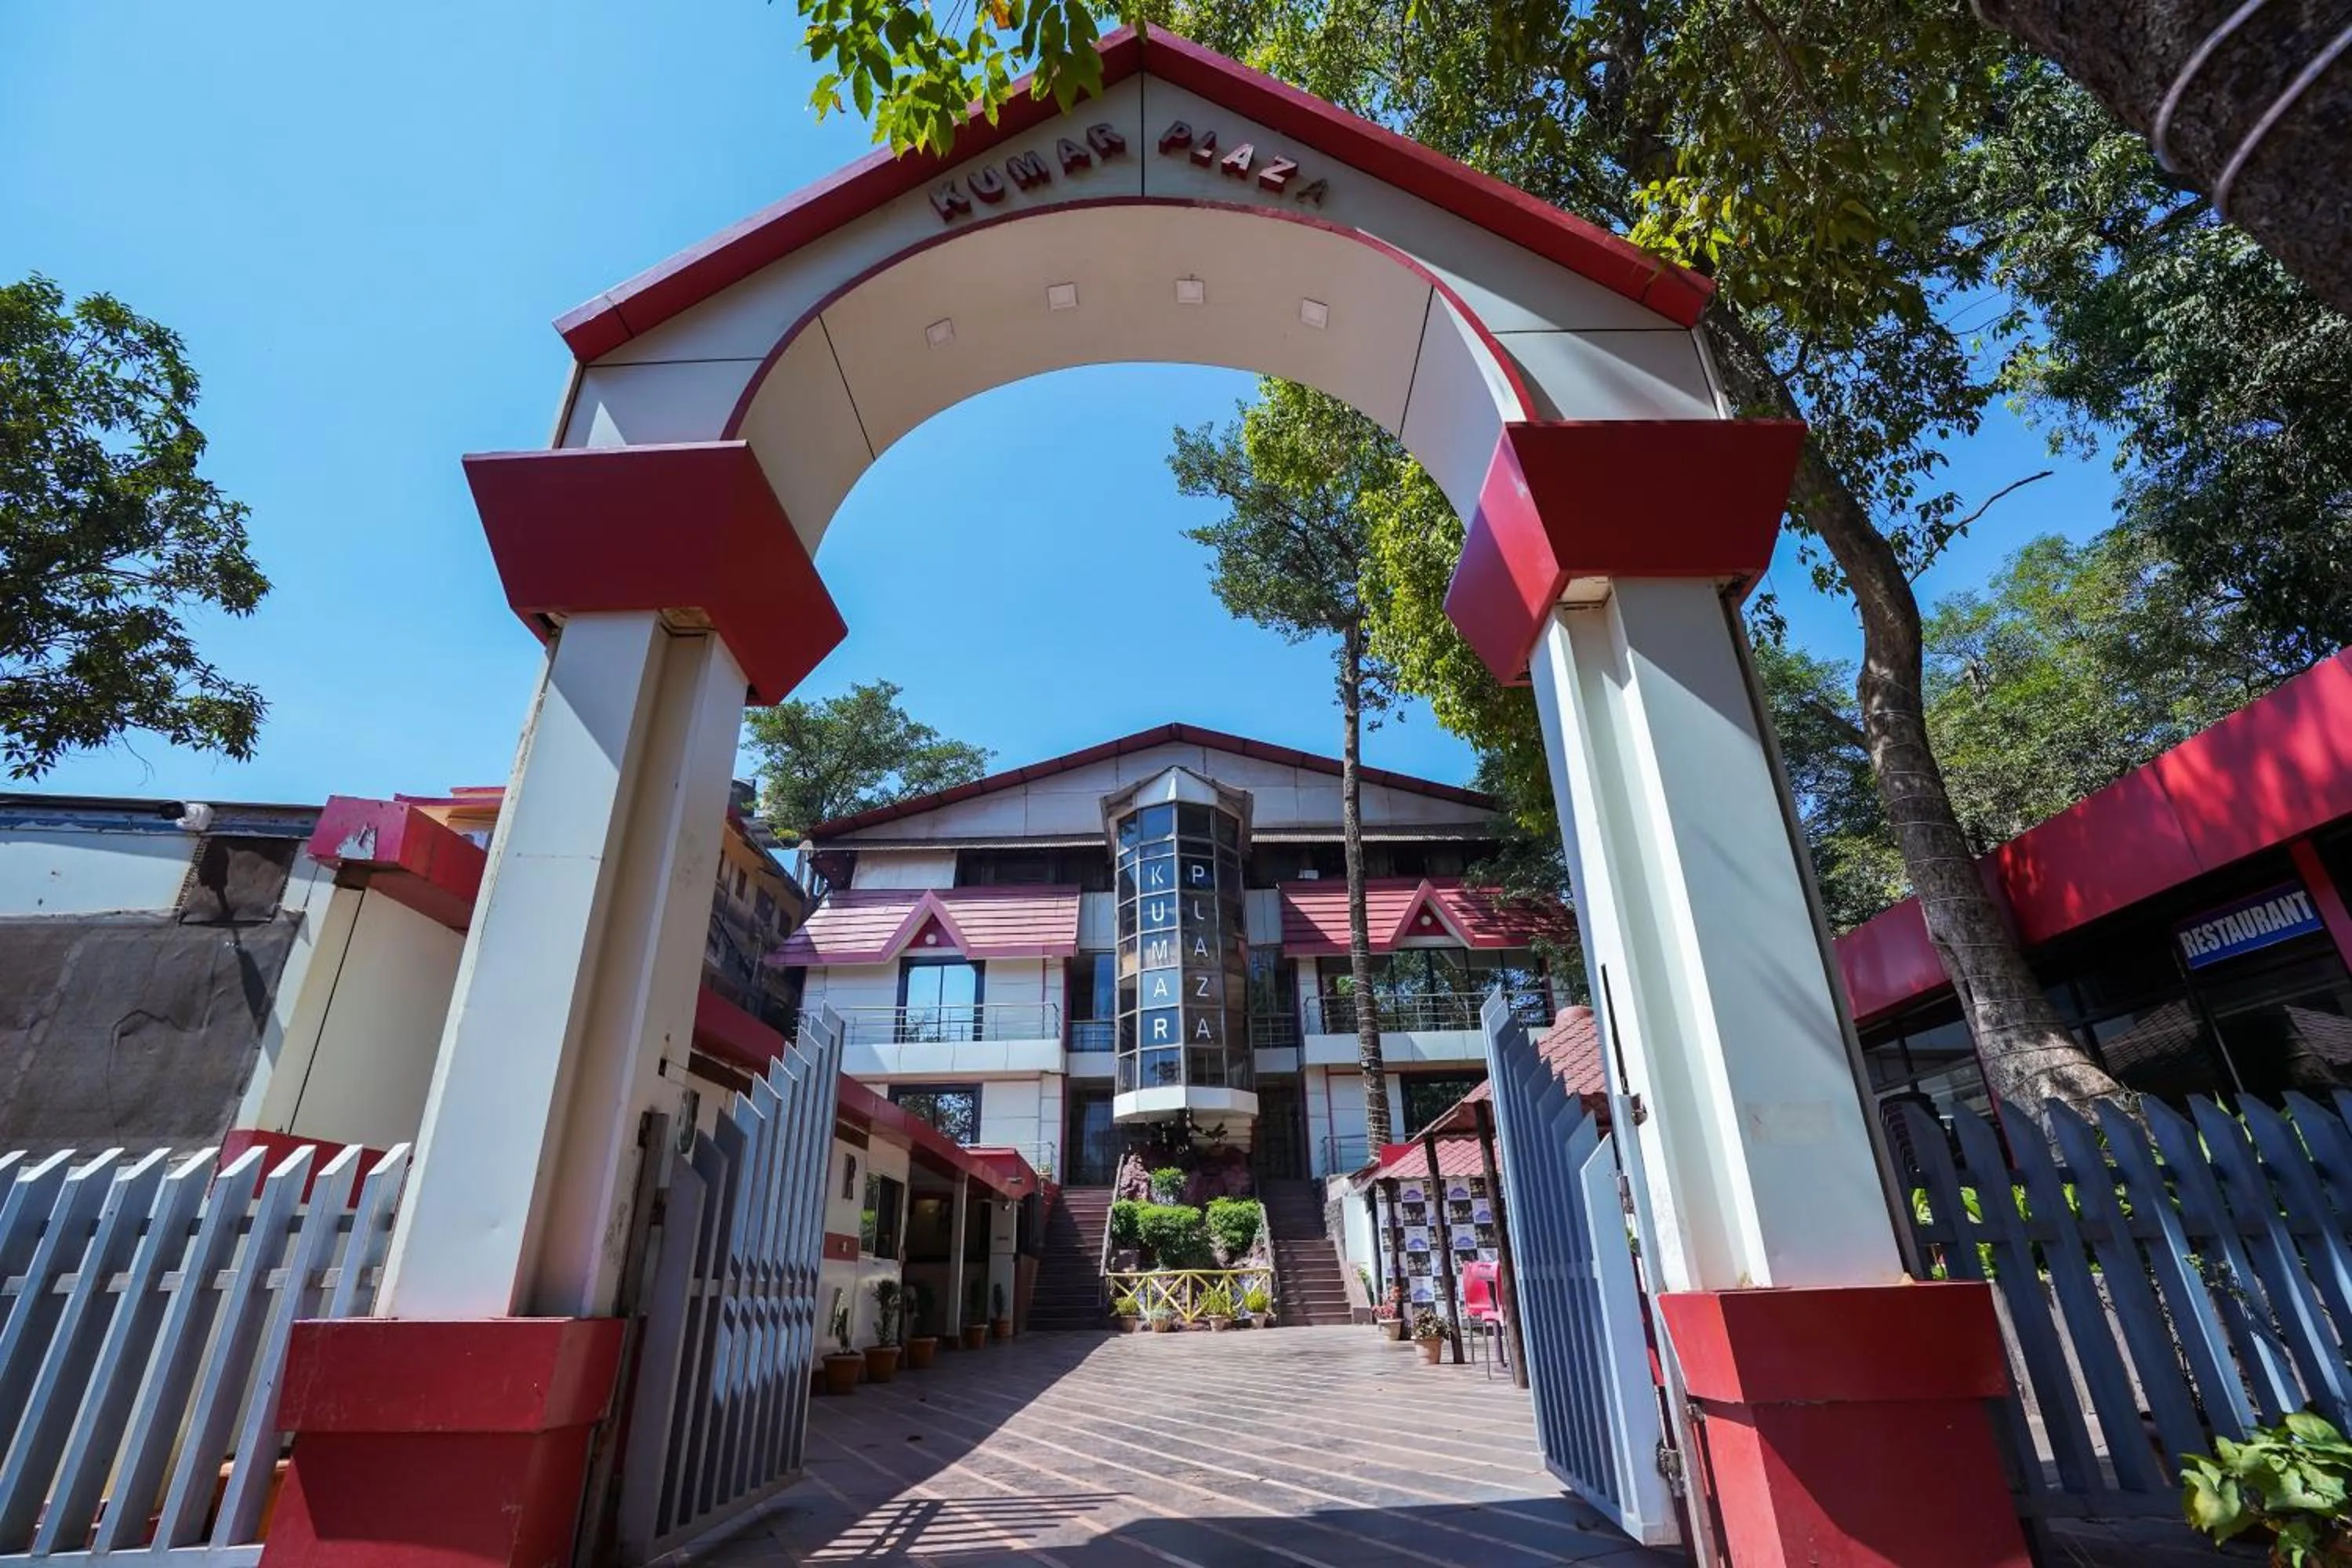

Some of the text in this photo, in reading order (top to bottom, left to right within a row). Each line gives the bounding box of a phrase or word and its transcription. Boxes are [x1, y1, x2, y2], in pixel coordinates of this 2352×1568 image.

[928, 119, 1329, 222] KUMAR PLAZA
[1152, 865, 1167, 1039] KUMAR
[1192, 865, 1211, 1040] PLAZA
[2179, 891, 2314, 958] RESTAURANT
